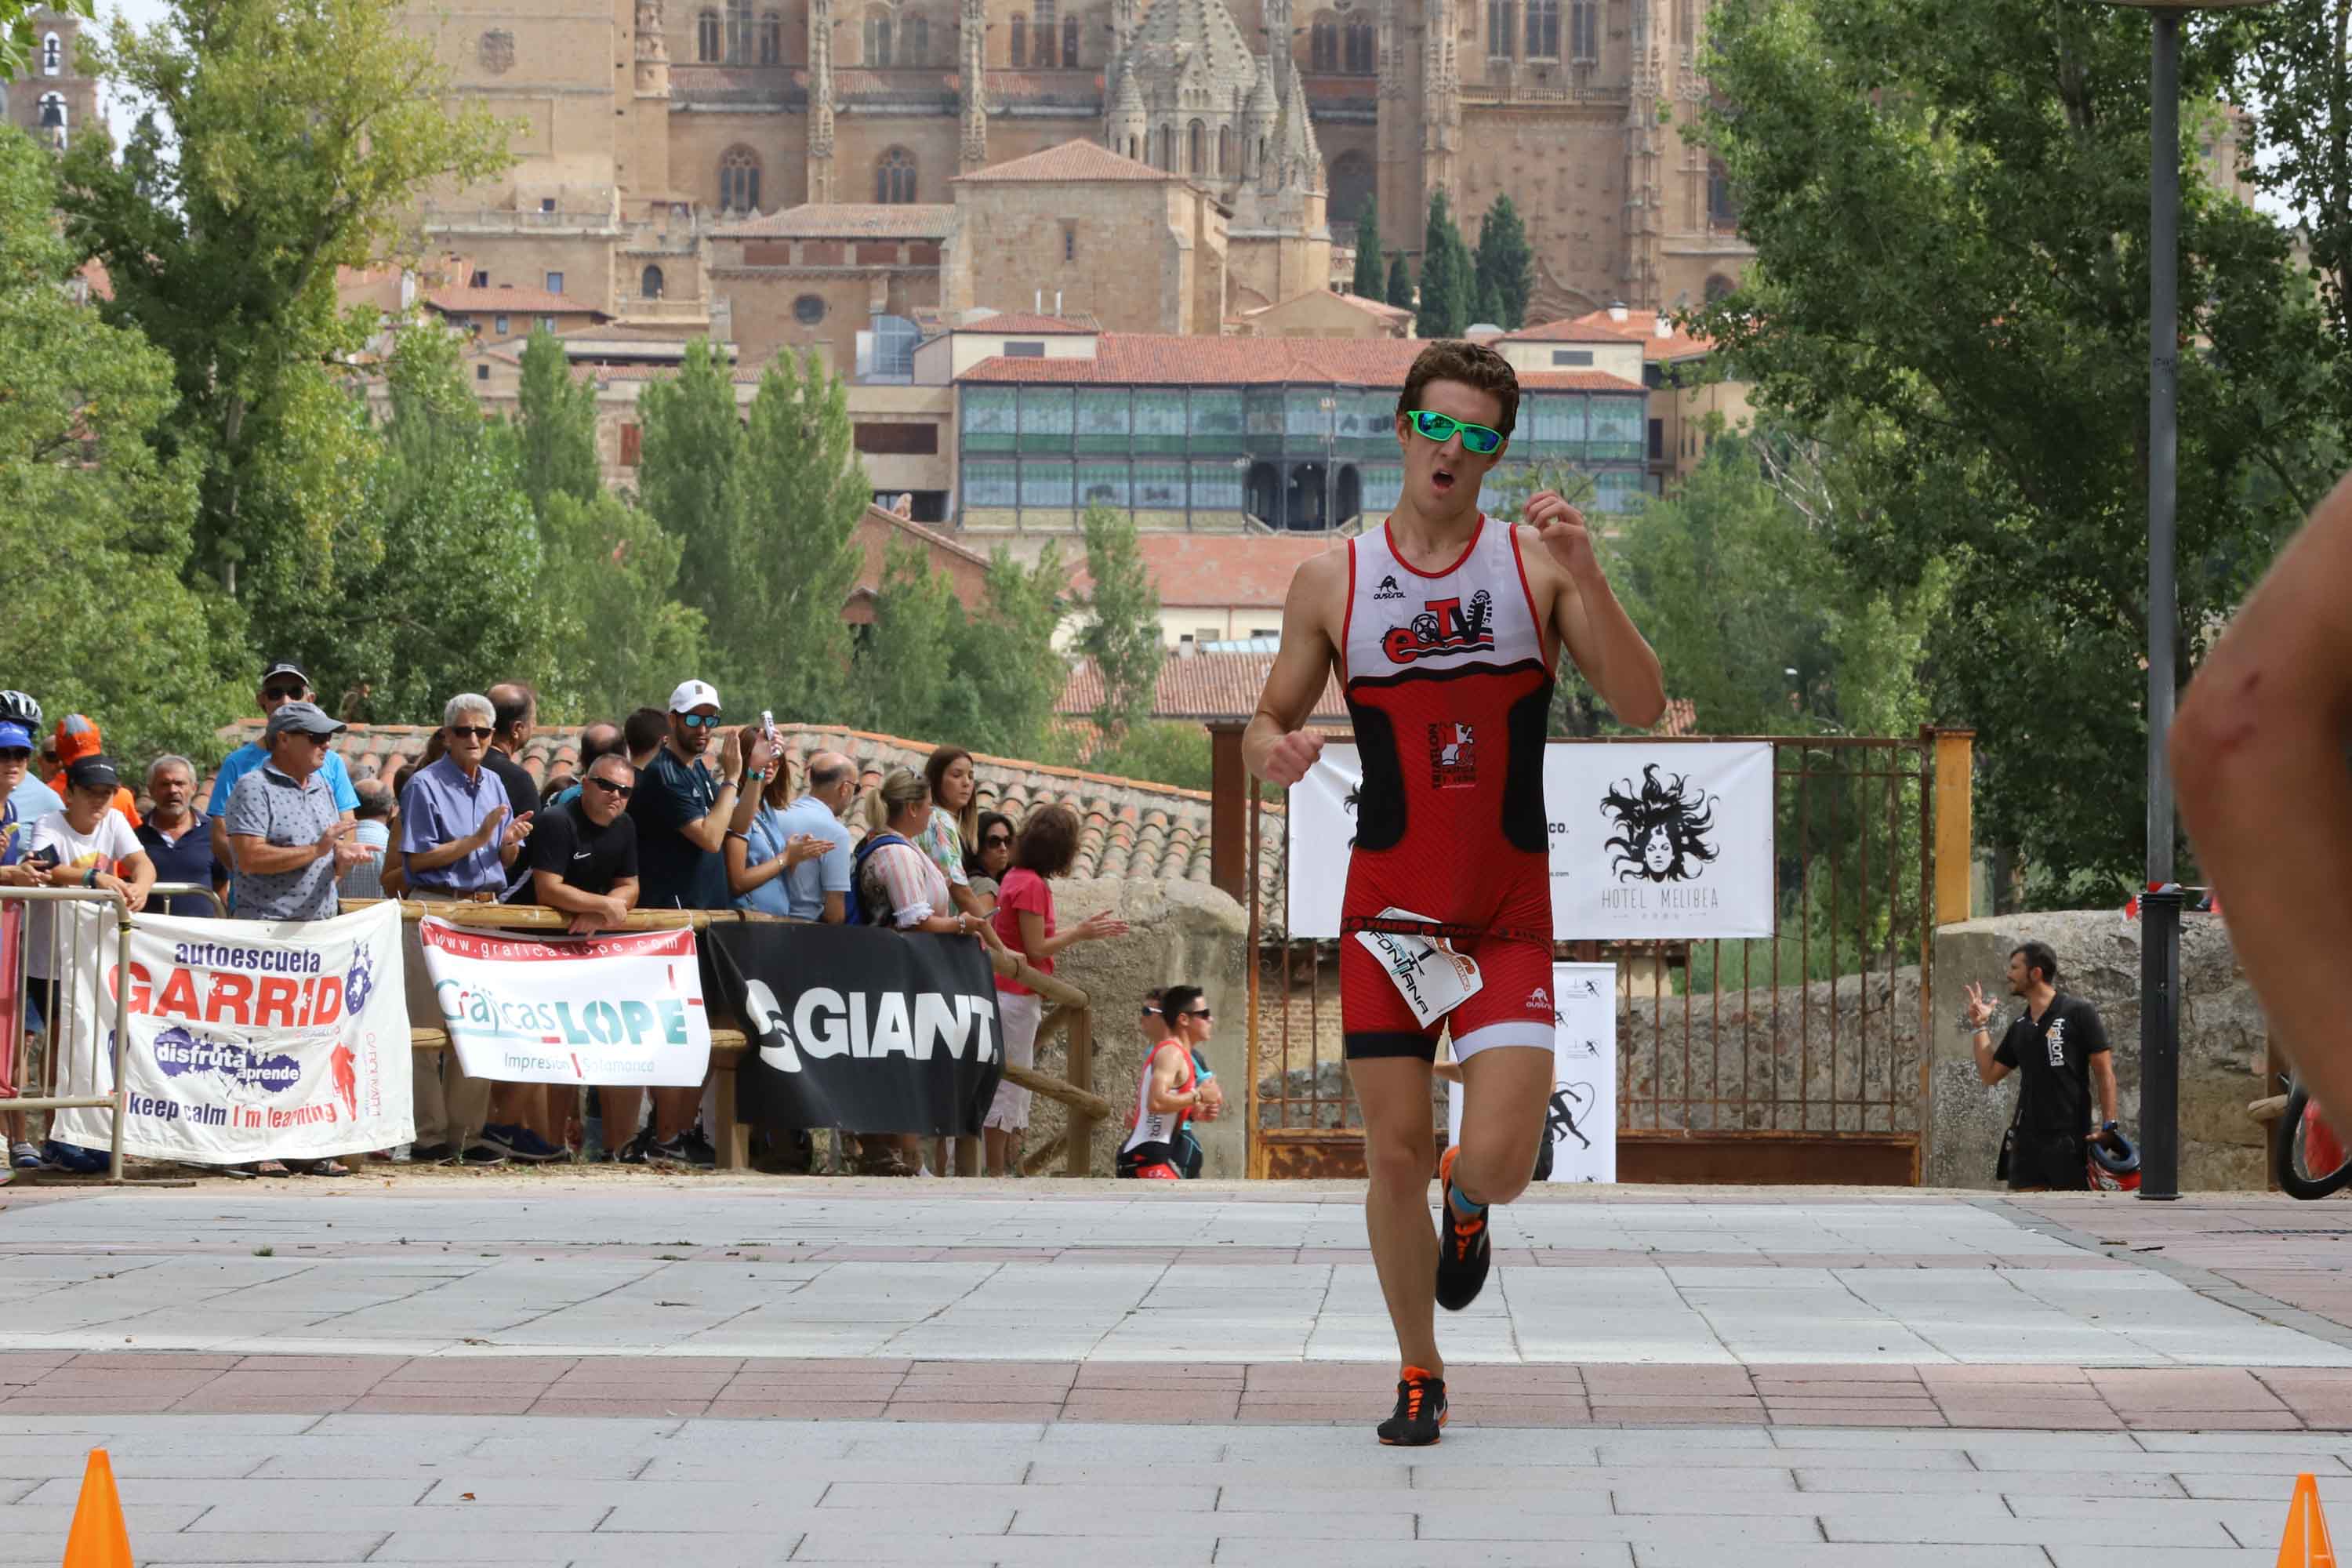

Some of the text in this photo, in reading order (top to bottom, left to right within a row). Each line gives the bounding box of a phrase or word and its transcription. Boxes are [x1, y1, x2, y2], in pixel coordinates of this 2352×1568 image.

[1601, 887, 1719, 909] HOTEL MELIBEA
[175, 942, 321, 973] autoescuela
[434, 932, 678, 958] www.graficaslope.com
[554, 1000, 688, 1045] LOPE
[793, 987, 994, 1063] GIANT
[156, 1042, 248, 1069] disfruta
[236, 1065, 299, 1082] aprende
[129, 1092, 179, 1122] keep
[184, 1103, 227, 1126] calm
[267, 1102, 337, 1128] learning
